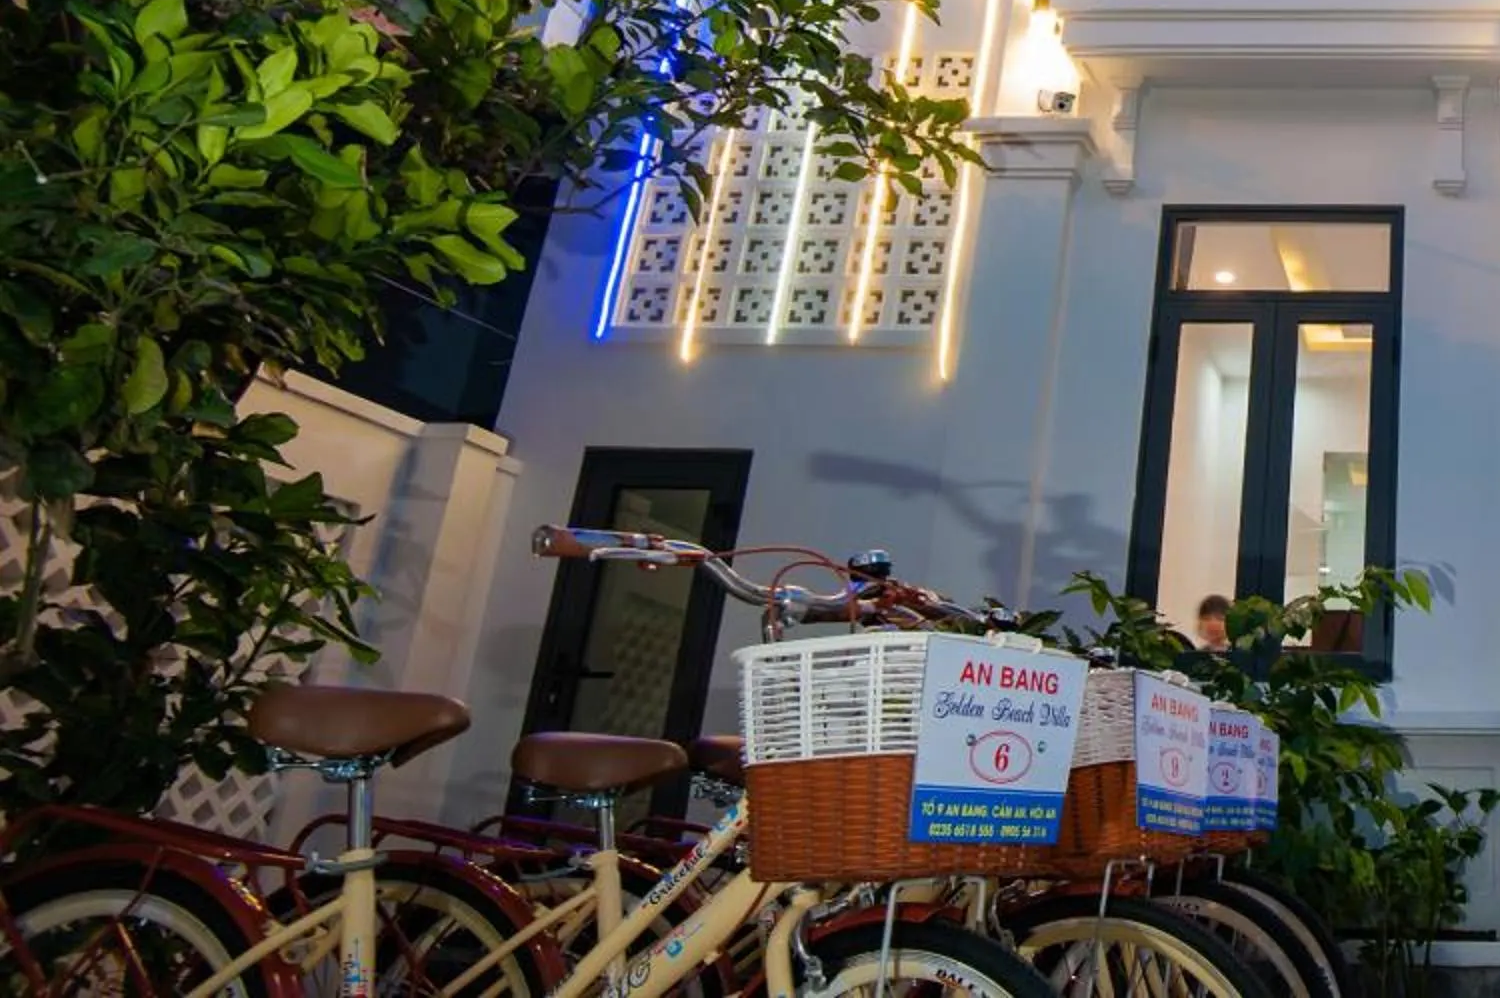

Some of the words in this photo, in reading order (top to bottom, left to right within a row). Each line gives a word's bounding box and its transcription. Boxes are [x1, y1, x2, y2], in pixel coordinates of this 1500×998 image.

[960, 661, 993, 687] AN
[1000, 666, 1059, 694] BANG
[933, 691, 985, 719] Golden
[992, 697, 1034, 724] Beach
[1151, 693, 1167, 711] AN
[1219, 722, 1249, 739] BANG
[994, 743, 1011, 772] 6
